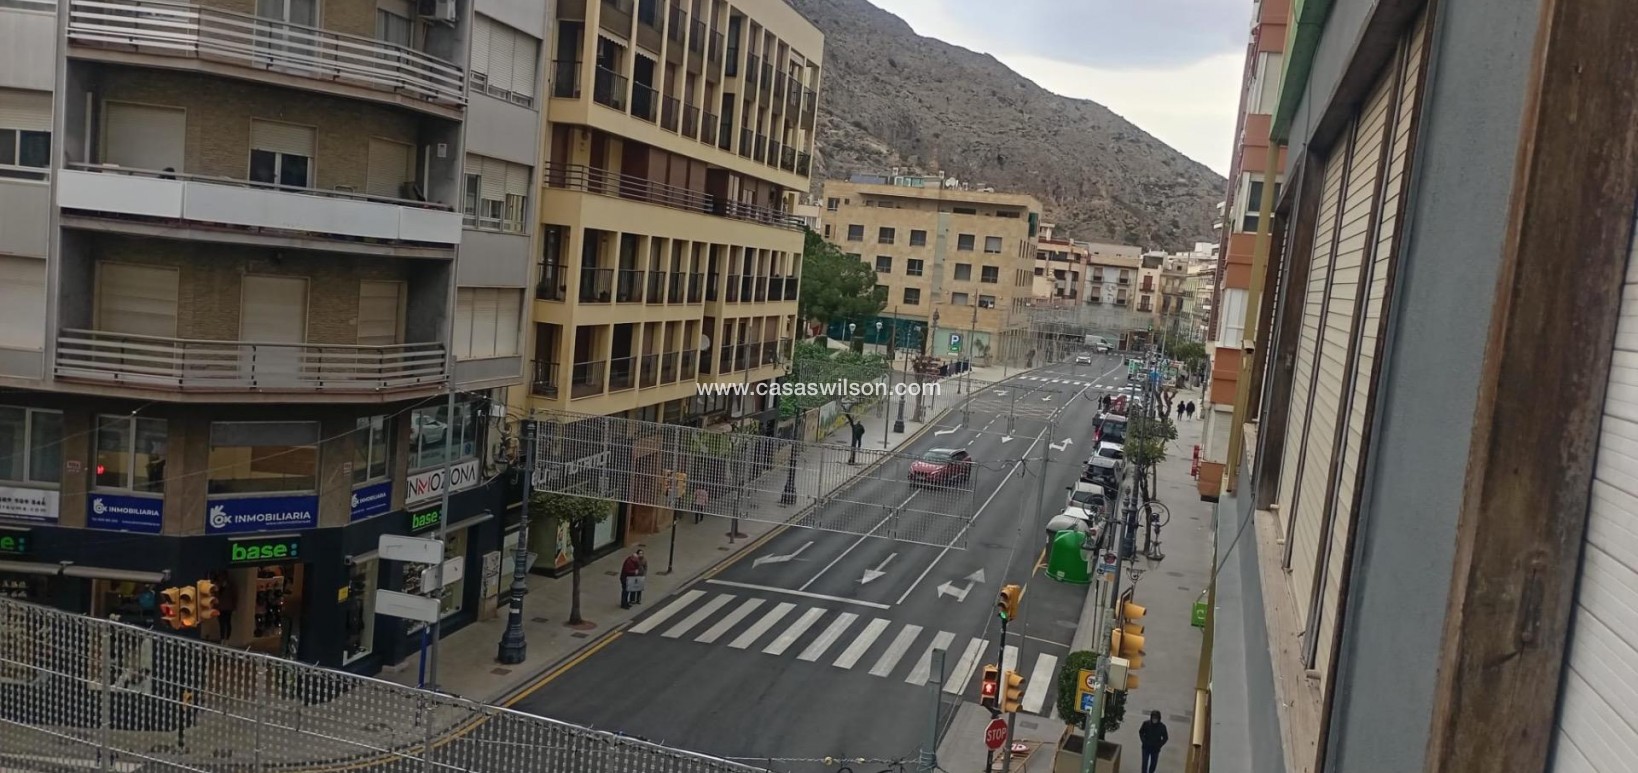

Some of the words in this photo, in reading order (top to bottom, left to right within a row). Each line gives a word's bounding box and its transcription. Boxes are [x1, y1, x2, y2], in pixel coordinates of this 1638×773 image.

[951, 335, 960, 345] P
[108, 506, 160, 516] INMOBILIARIA
[235, 511, 311, 524] INMOBILIARIA
[987, 727, 1007, 742] STOP
